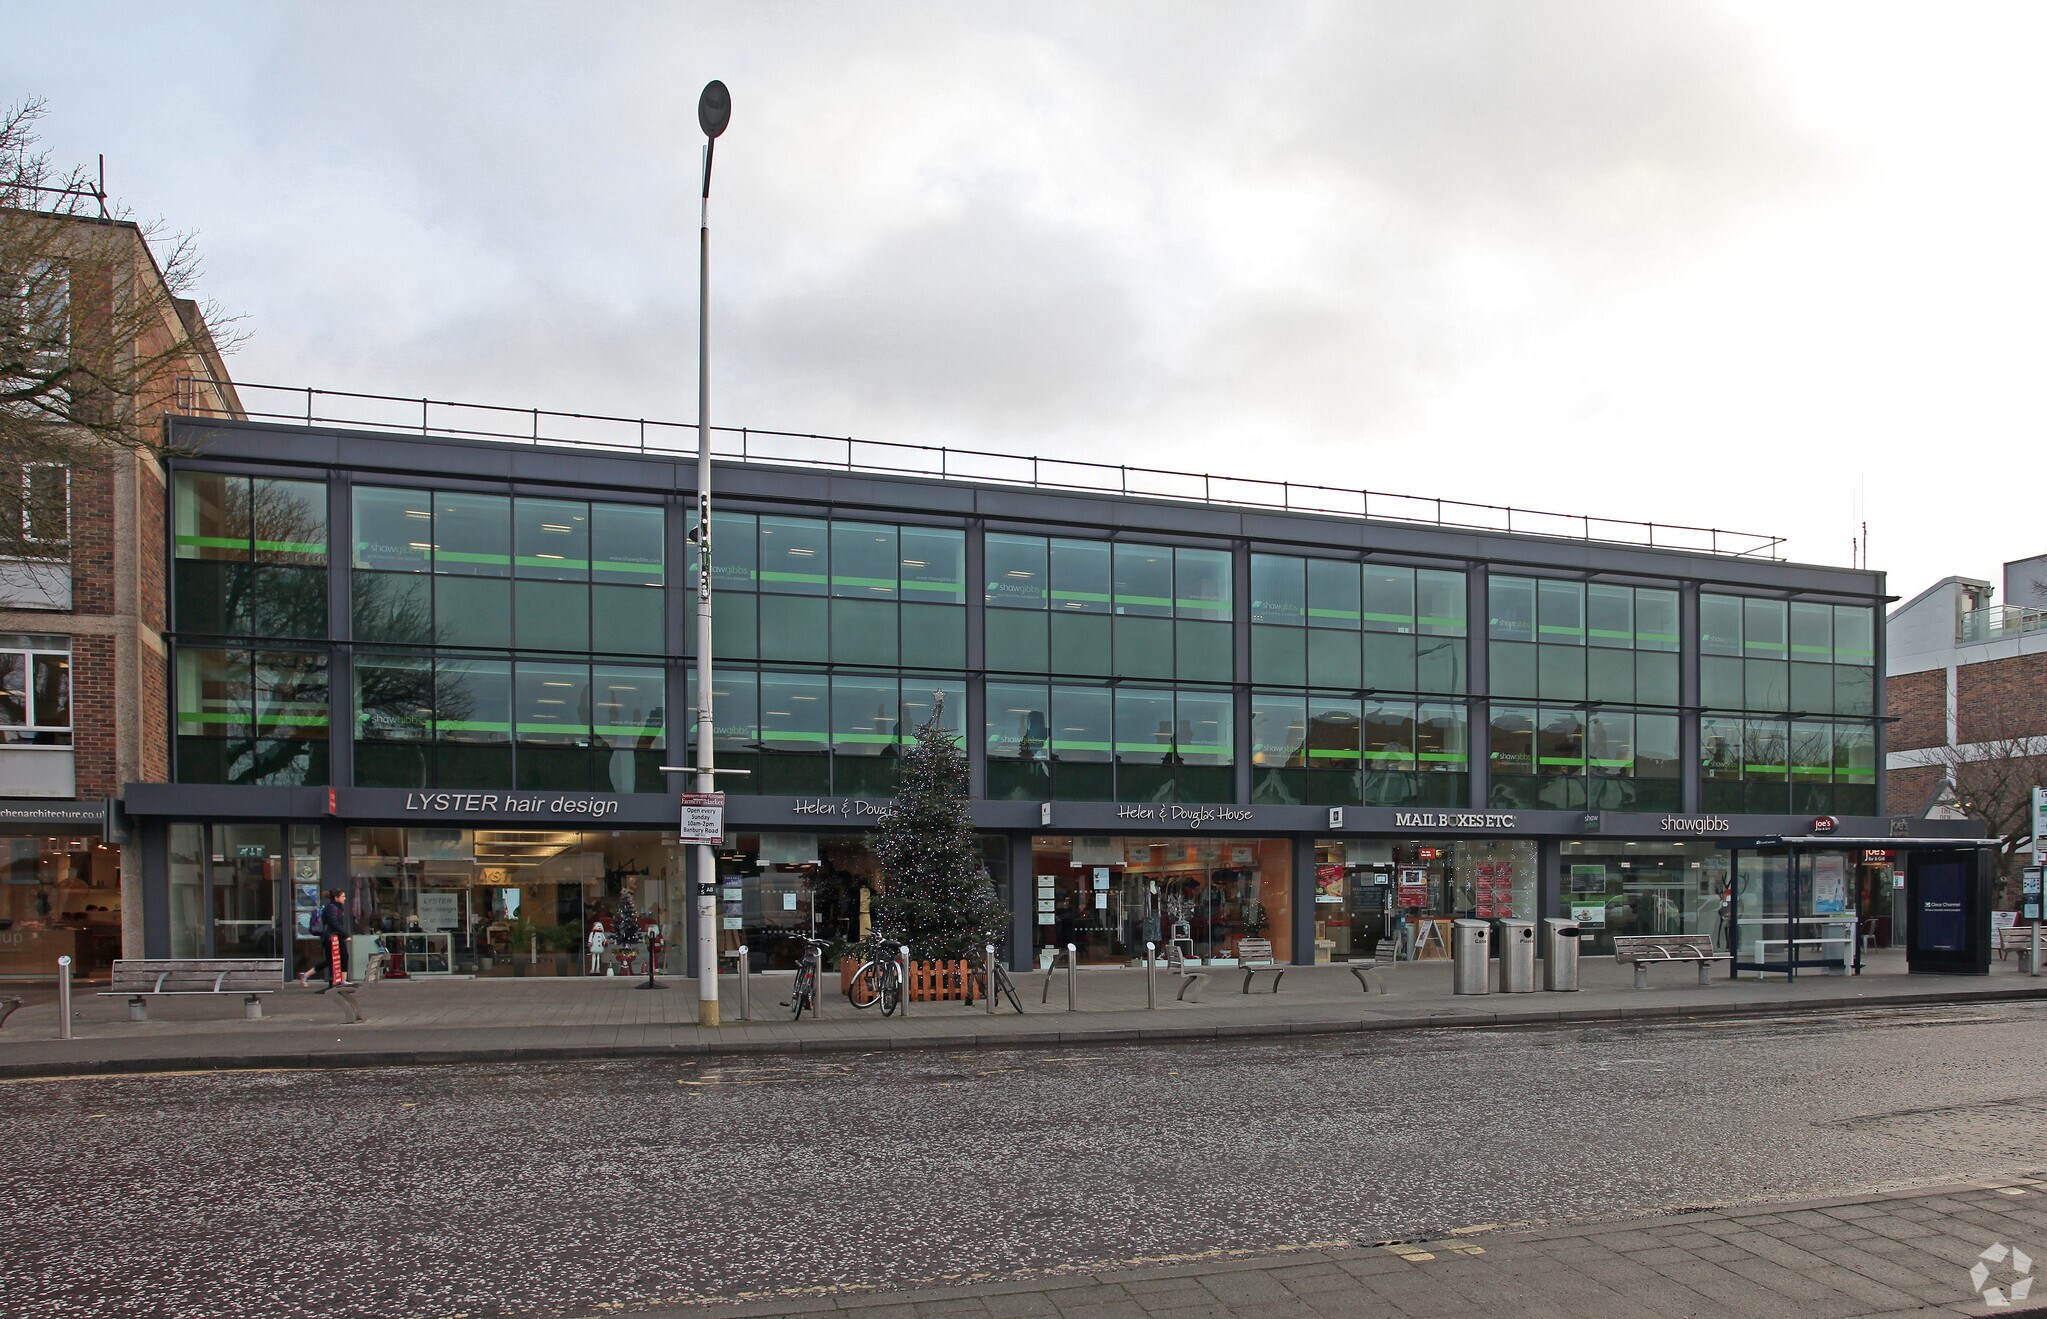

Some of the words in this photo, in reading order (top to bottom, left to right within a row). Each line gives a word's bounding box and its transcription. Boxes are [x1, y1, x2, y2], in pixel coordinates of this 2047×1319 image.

[712, 565, 749, 575] awgibbs
[1000, 581, 1040, 594] shawgibbs
[713, 726, 749, 736] awgibbs
[406, 793, 499, 812] LYSTER
[504, 795, 547, 813] hair
[550, 796, 619, 818] design
[793, 799, 836, 815] Helen
[841, 798, 851, 819] &
[1117, 804, 1155, 819] Helen
[1158, 803, 1168, 823] &
[1171, 805, 1215, 829] Douglas
[1216, 807, 1253, 821] House
[1395, 813, 1437, 827] MAIL
[1438, 814, 1484, 828] BOXES
[1584, 814, 1599, 822] shaw
[687, 820, 715, 828] 10am-2pm
[1661, 815, 1730, 835] shawgibbs
[1815, 819, 1831, 831] Joe's
[1889, 818, 1908, 837] Joe's
